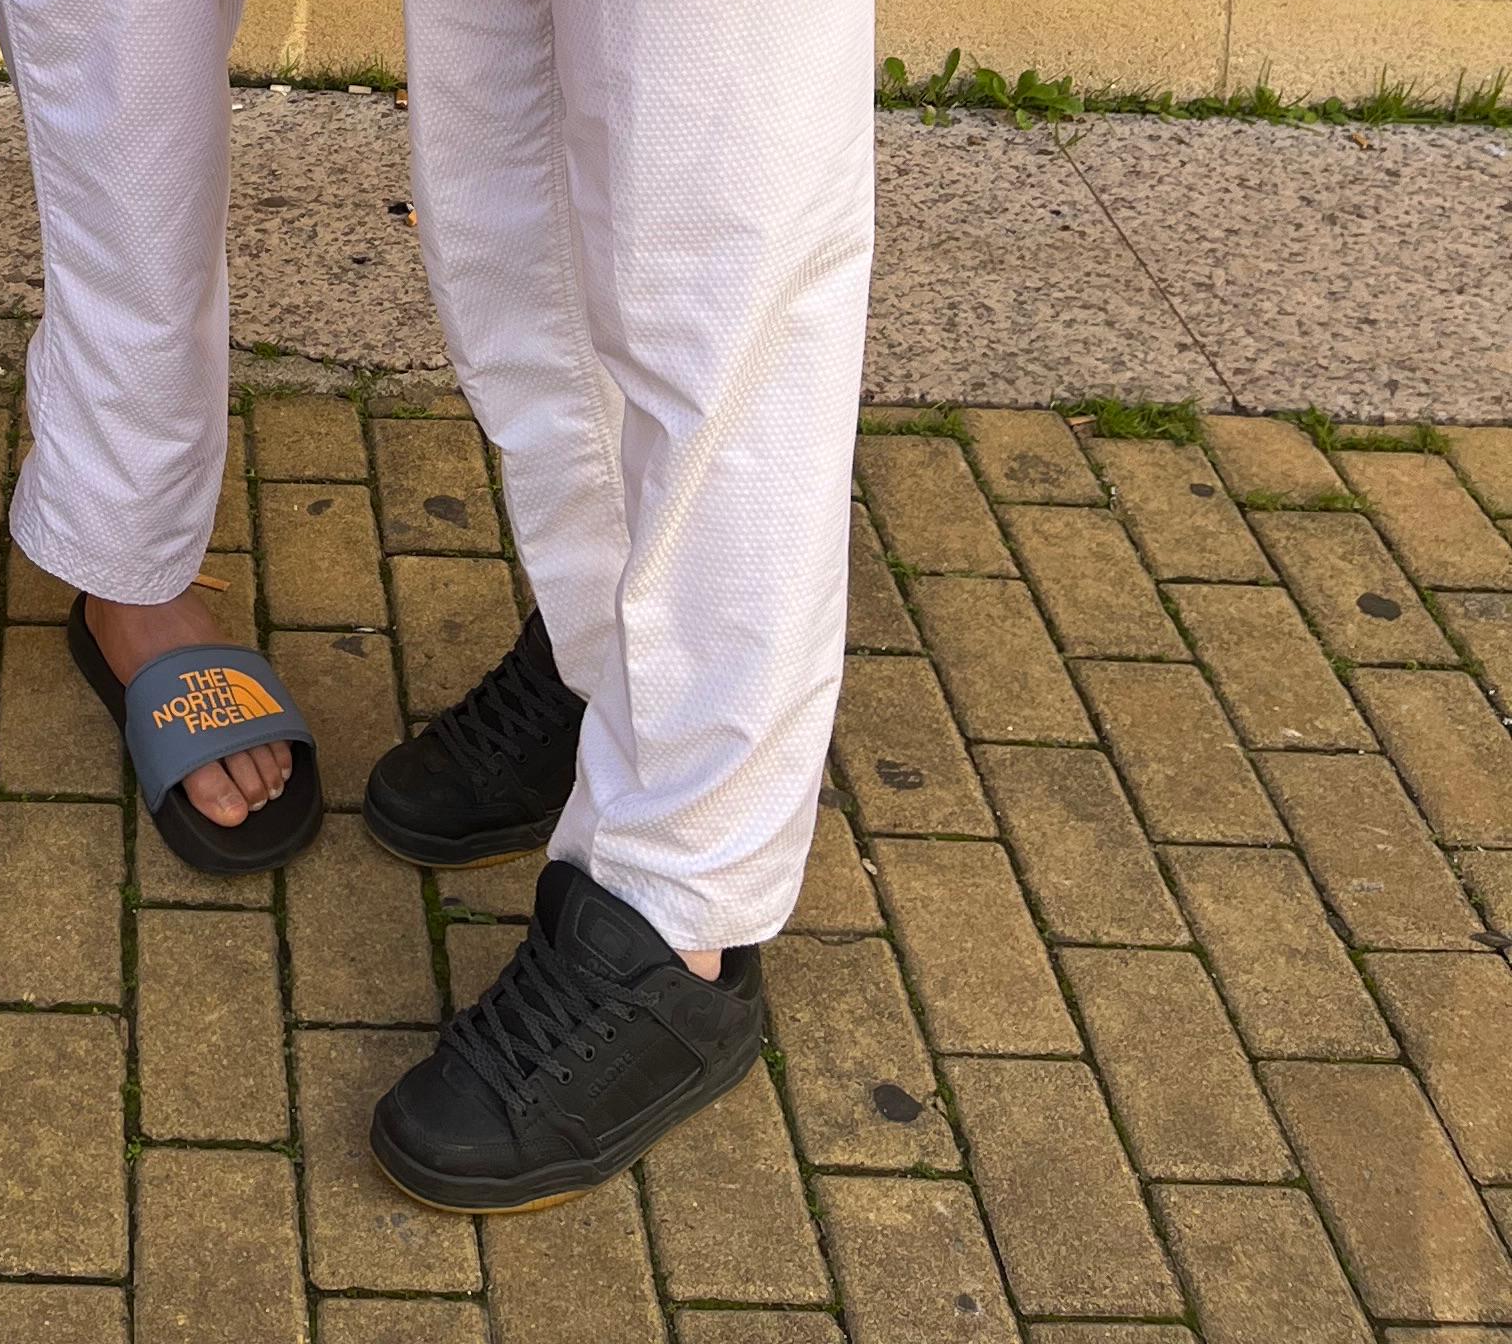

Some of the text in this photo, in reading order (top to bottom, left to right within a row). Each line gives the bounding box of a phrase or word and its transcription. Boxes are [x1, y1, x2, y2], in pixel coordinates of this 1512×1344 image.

[178, 668, 227, 692] THE
[152, 686, 235, 729] NORTH
[183, 706, 245, 734] FACE
